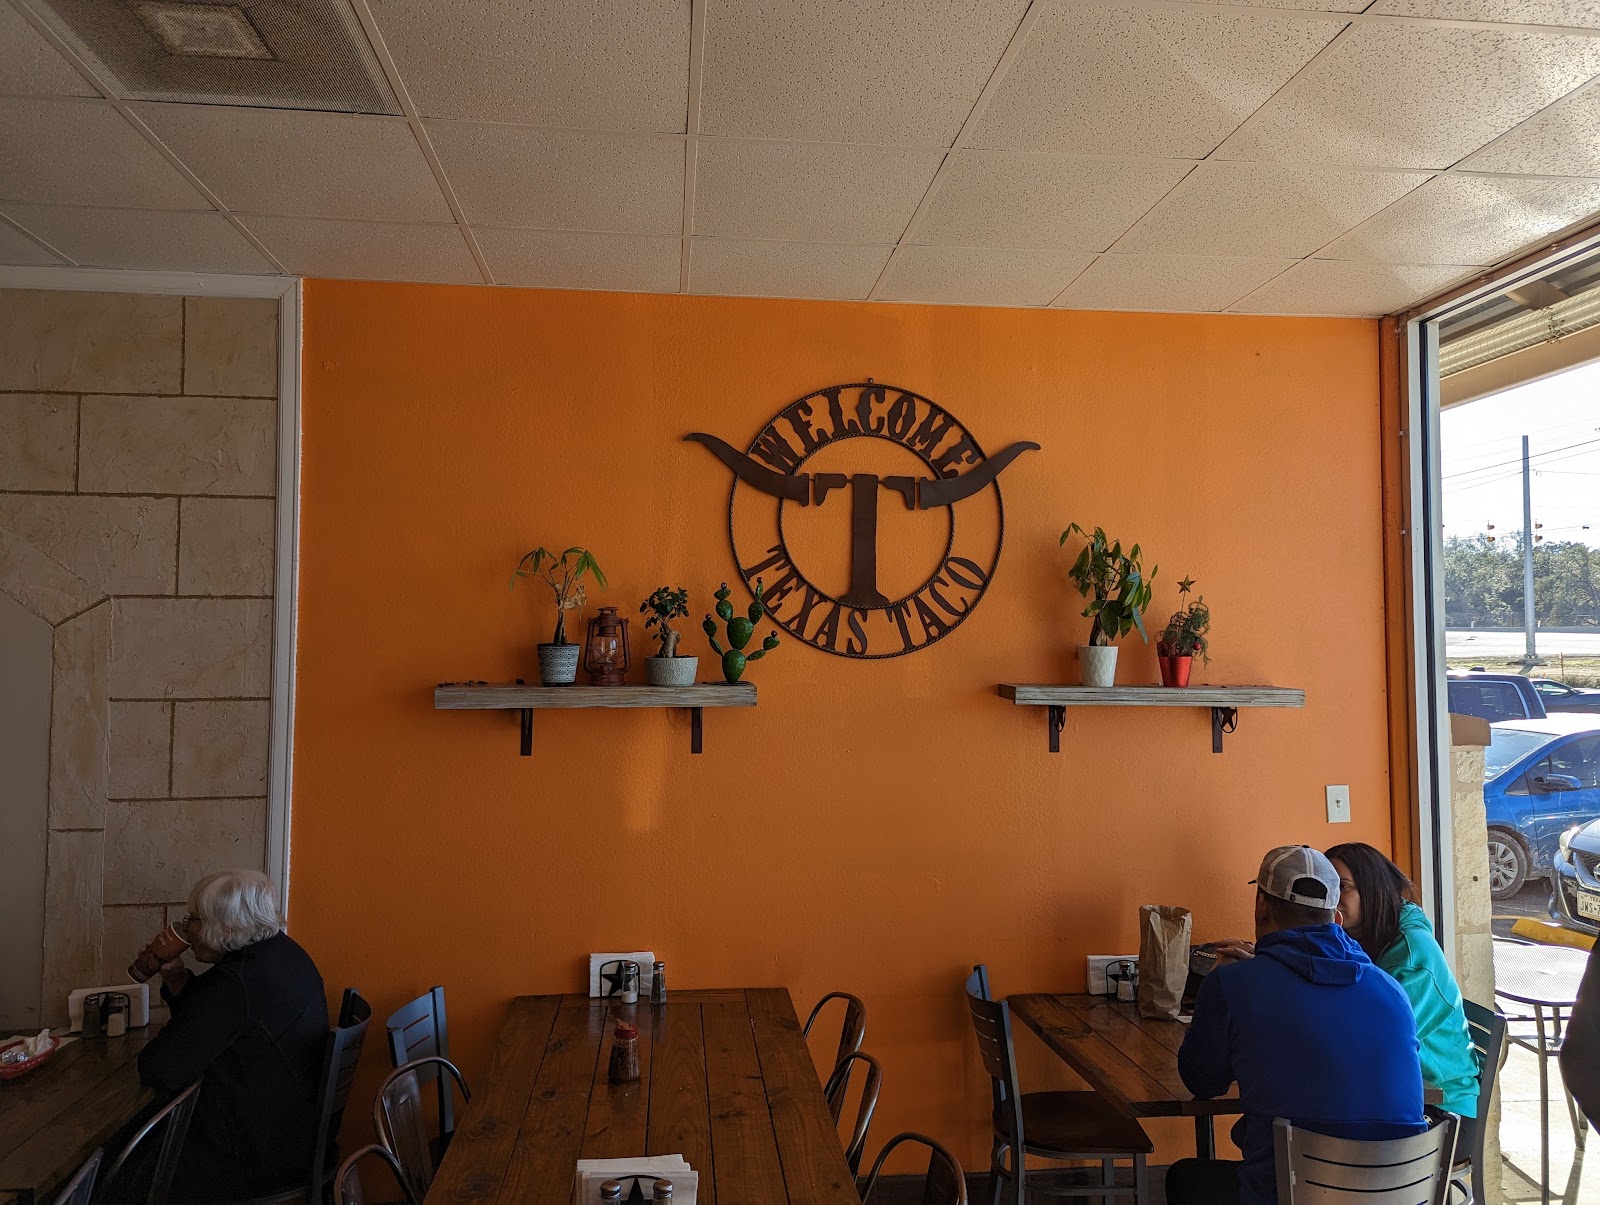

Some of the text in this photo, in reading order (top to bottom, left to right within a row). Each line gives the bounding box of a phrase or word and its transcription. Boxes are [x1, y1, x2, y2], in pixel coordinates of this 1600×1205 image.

[749, 387, 982, 478] WELCOME
[743, 544, 988, 655] TEXAS TACO
